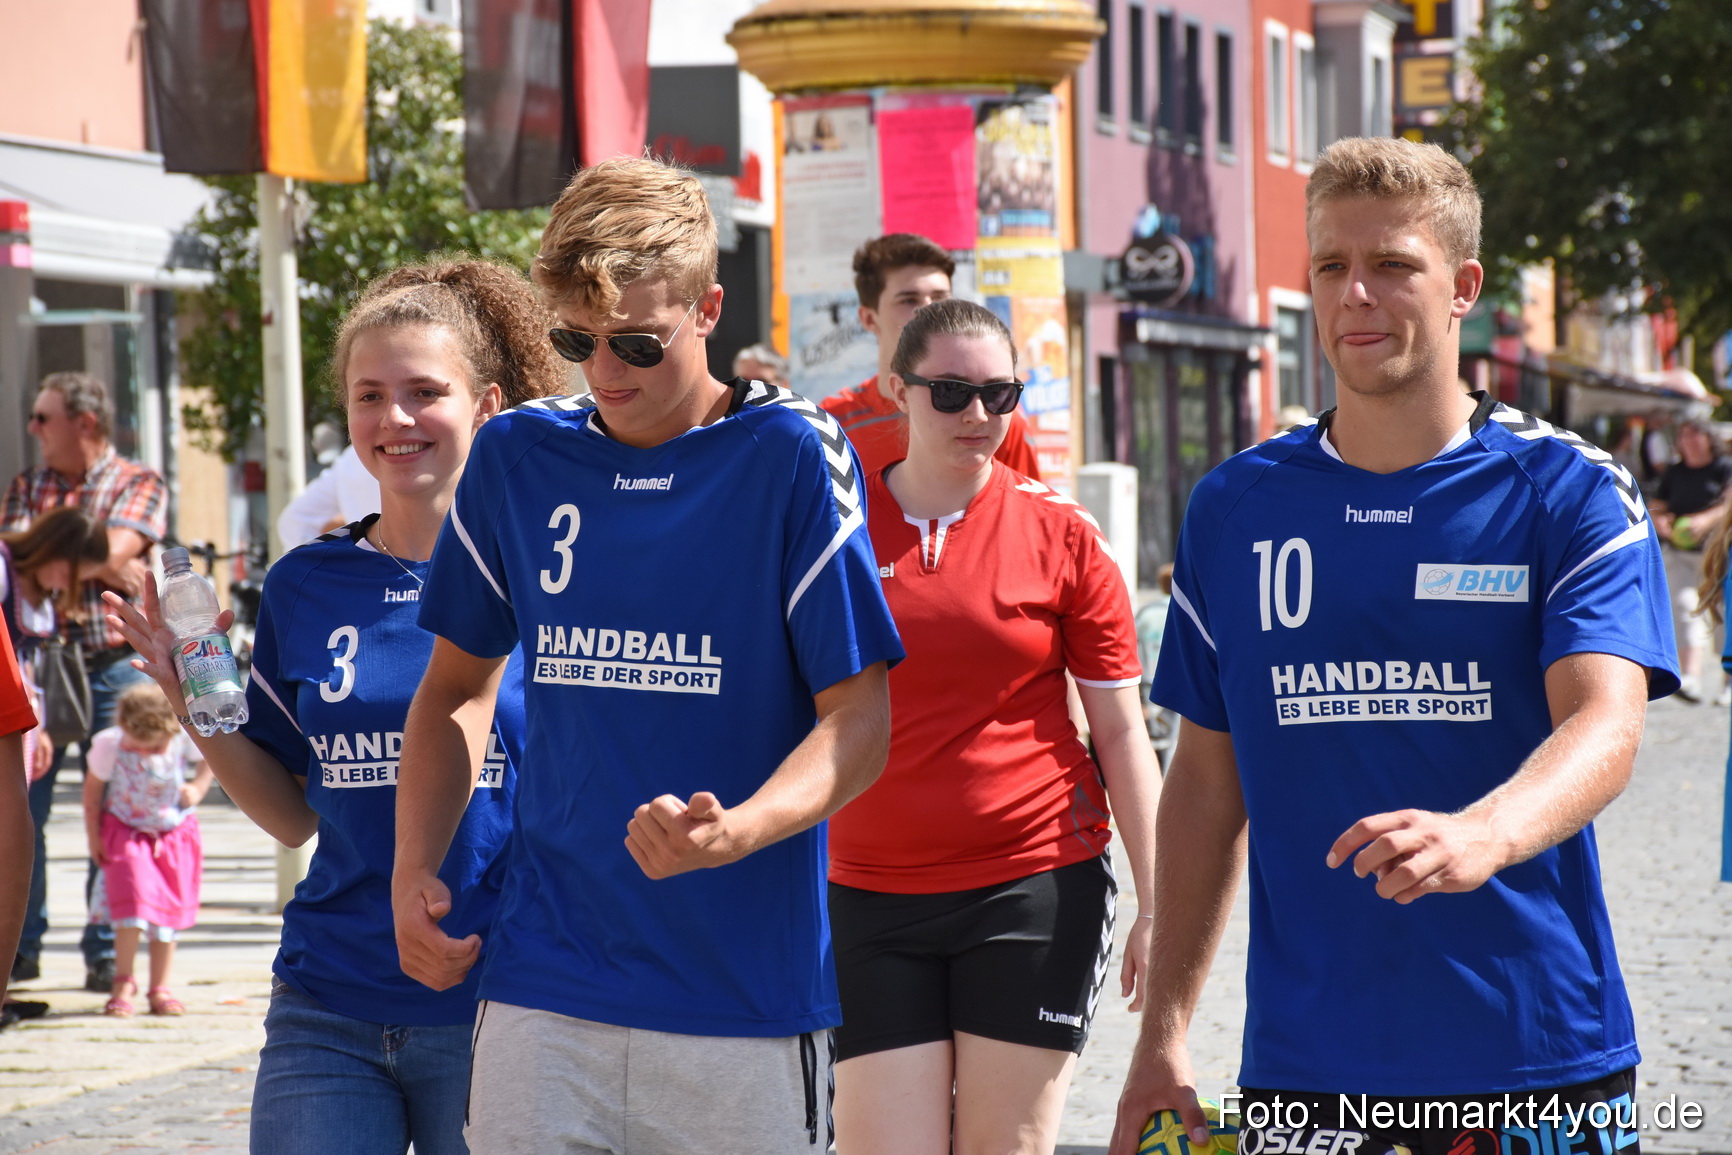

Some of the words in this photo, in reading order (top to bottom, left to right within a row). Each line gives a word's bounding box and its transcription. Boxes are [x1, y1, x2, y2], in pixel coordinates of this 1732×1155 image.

[612, 473, 674, 490] hummel
[1345, 504, 1414, 524] hummel
[539, 503, 581, 594] 3
[1252, 537, 1313, 631] 10
[1456, 569, 1526, 592] BHV
[384, 587, 420, 602] hum
[536, 624, 722, 665] HANDBALL
[319, 625, 359, 703] 3
[537, 662, 558, 678] ES
[602, 666, 643, 684] DER
[647, 669, 718, 689] SPORT
[1271, 660, 1492, 695] HANDBALL
[1279, 702, 1301, 719] ES
[1308, 699, 1361, 717] LEBE
[1368, 699, 1410, 715] DER
[1417, 698, 1489, 716] SPORT
[339, 766, 388, 783] LEBE
